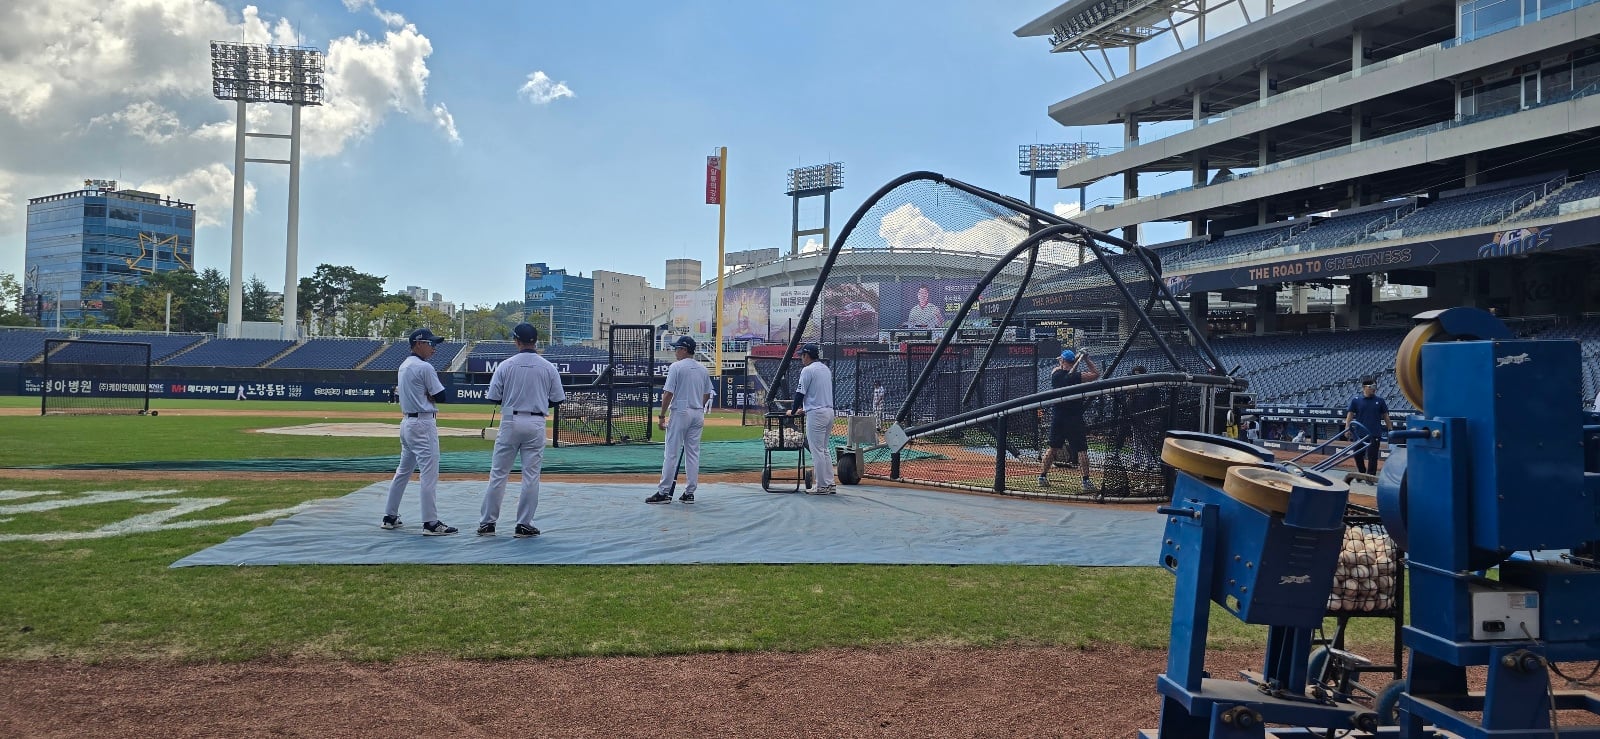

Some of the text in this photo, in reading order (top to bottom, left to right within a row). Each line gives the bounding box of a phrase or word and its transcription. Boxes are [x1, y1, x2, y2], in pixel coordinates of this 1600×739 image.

[1249, 248, 1412, 281] THE ROAD TO GREATNESS
[246, 384, 286, 396] 노랑통닭
[457, 390, 482, 399] BMW
